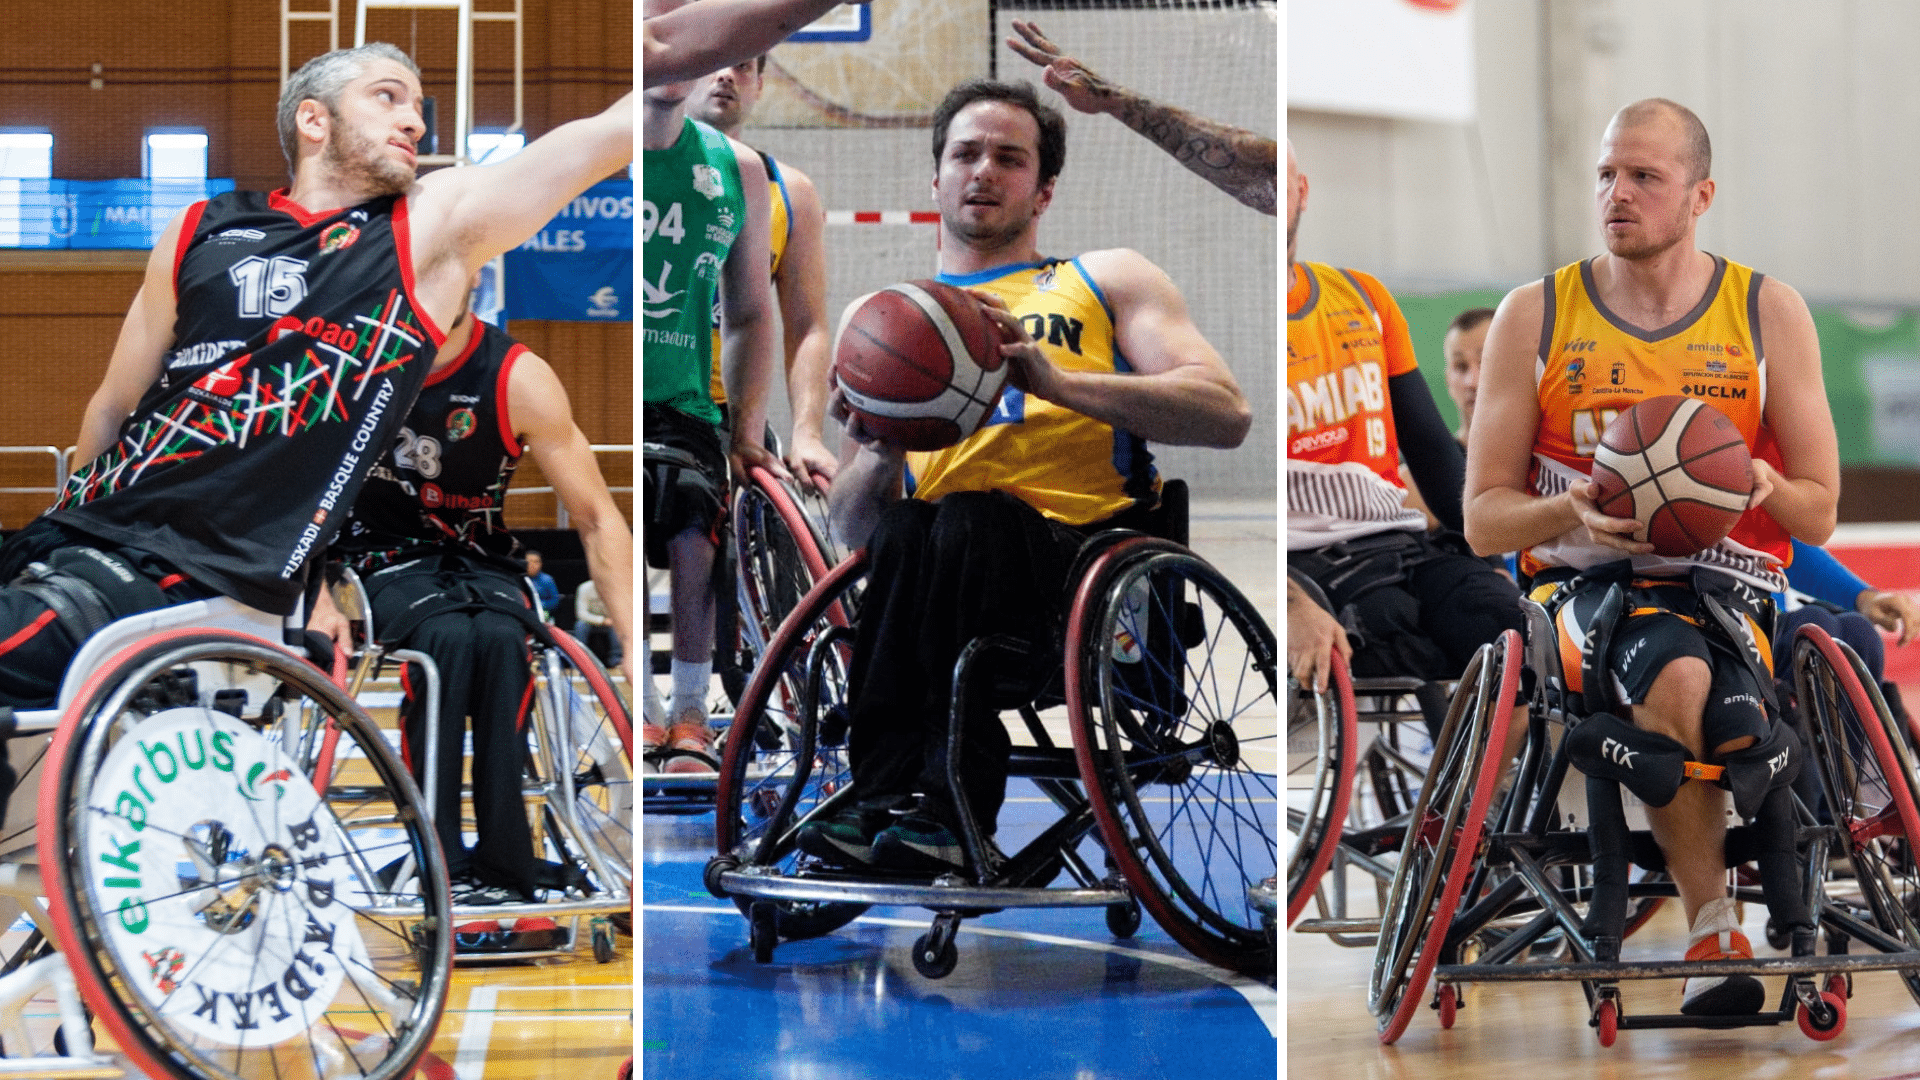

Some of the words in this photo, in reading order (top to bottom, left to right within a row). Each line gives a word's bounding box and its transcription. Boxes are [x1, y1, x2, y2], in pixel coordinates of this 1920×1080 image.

[643, 200, 686, 244] 94
[229, 255, 309, 318] 15
[1686, 342, 1724, 353] amiab
[1287, 361, 1384, 437] AMIAB
[1693, 384, 1747, 400] UCLM
[319, 451, 360, 511] BASQUE
[352, 377, 395, 452] COUNTRY
[393, 426, 442, 480] 28
[1365, 416, 1387, 458] 19
[1581, 628, 1597, 670] FIX
[1602, 736, 1640, 770] FIX
[1767, 746, 1790, 780] FIX
[99, 728, 237, 935] elkarbus
